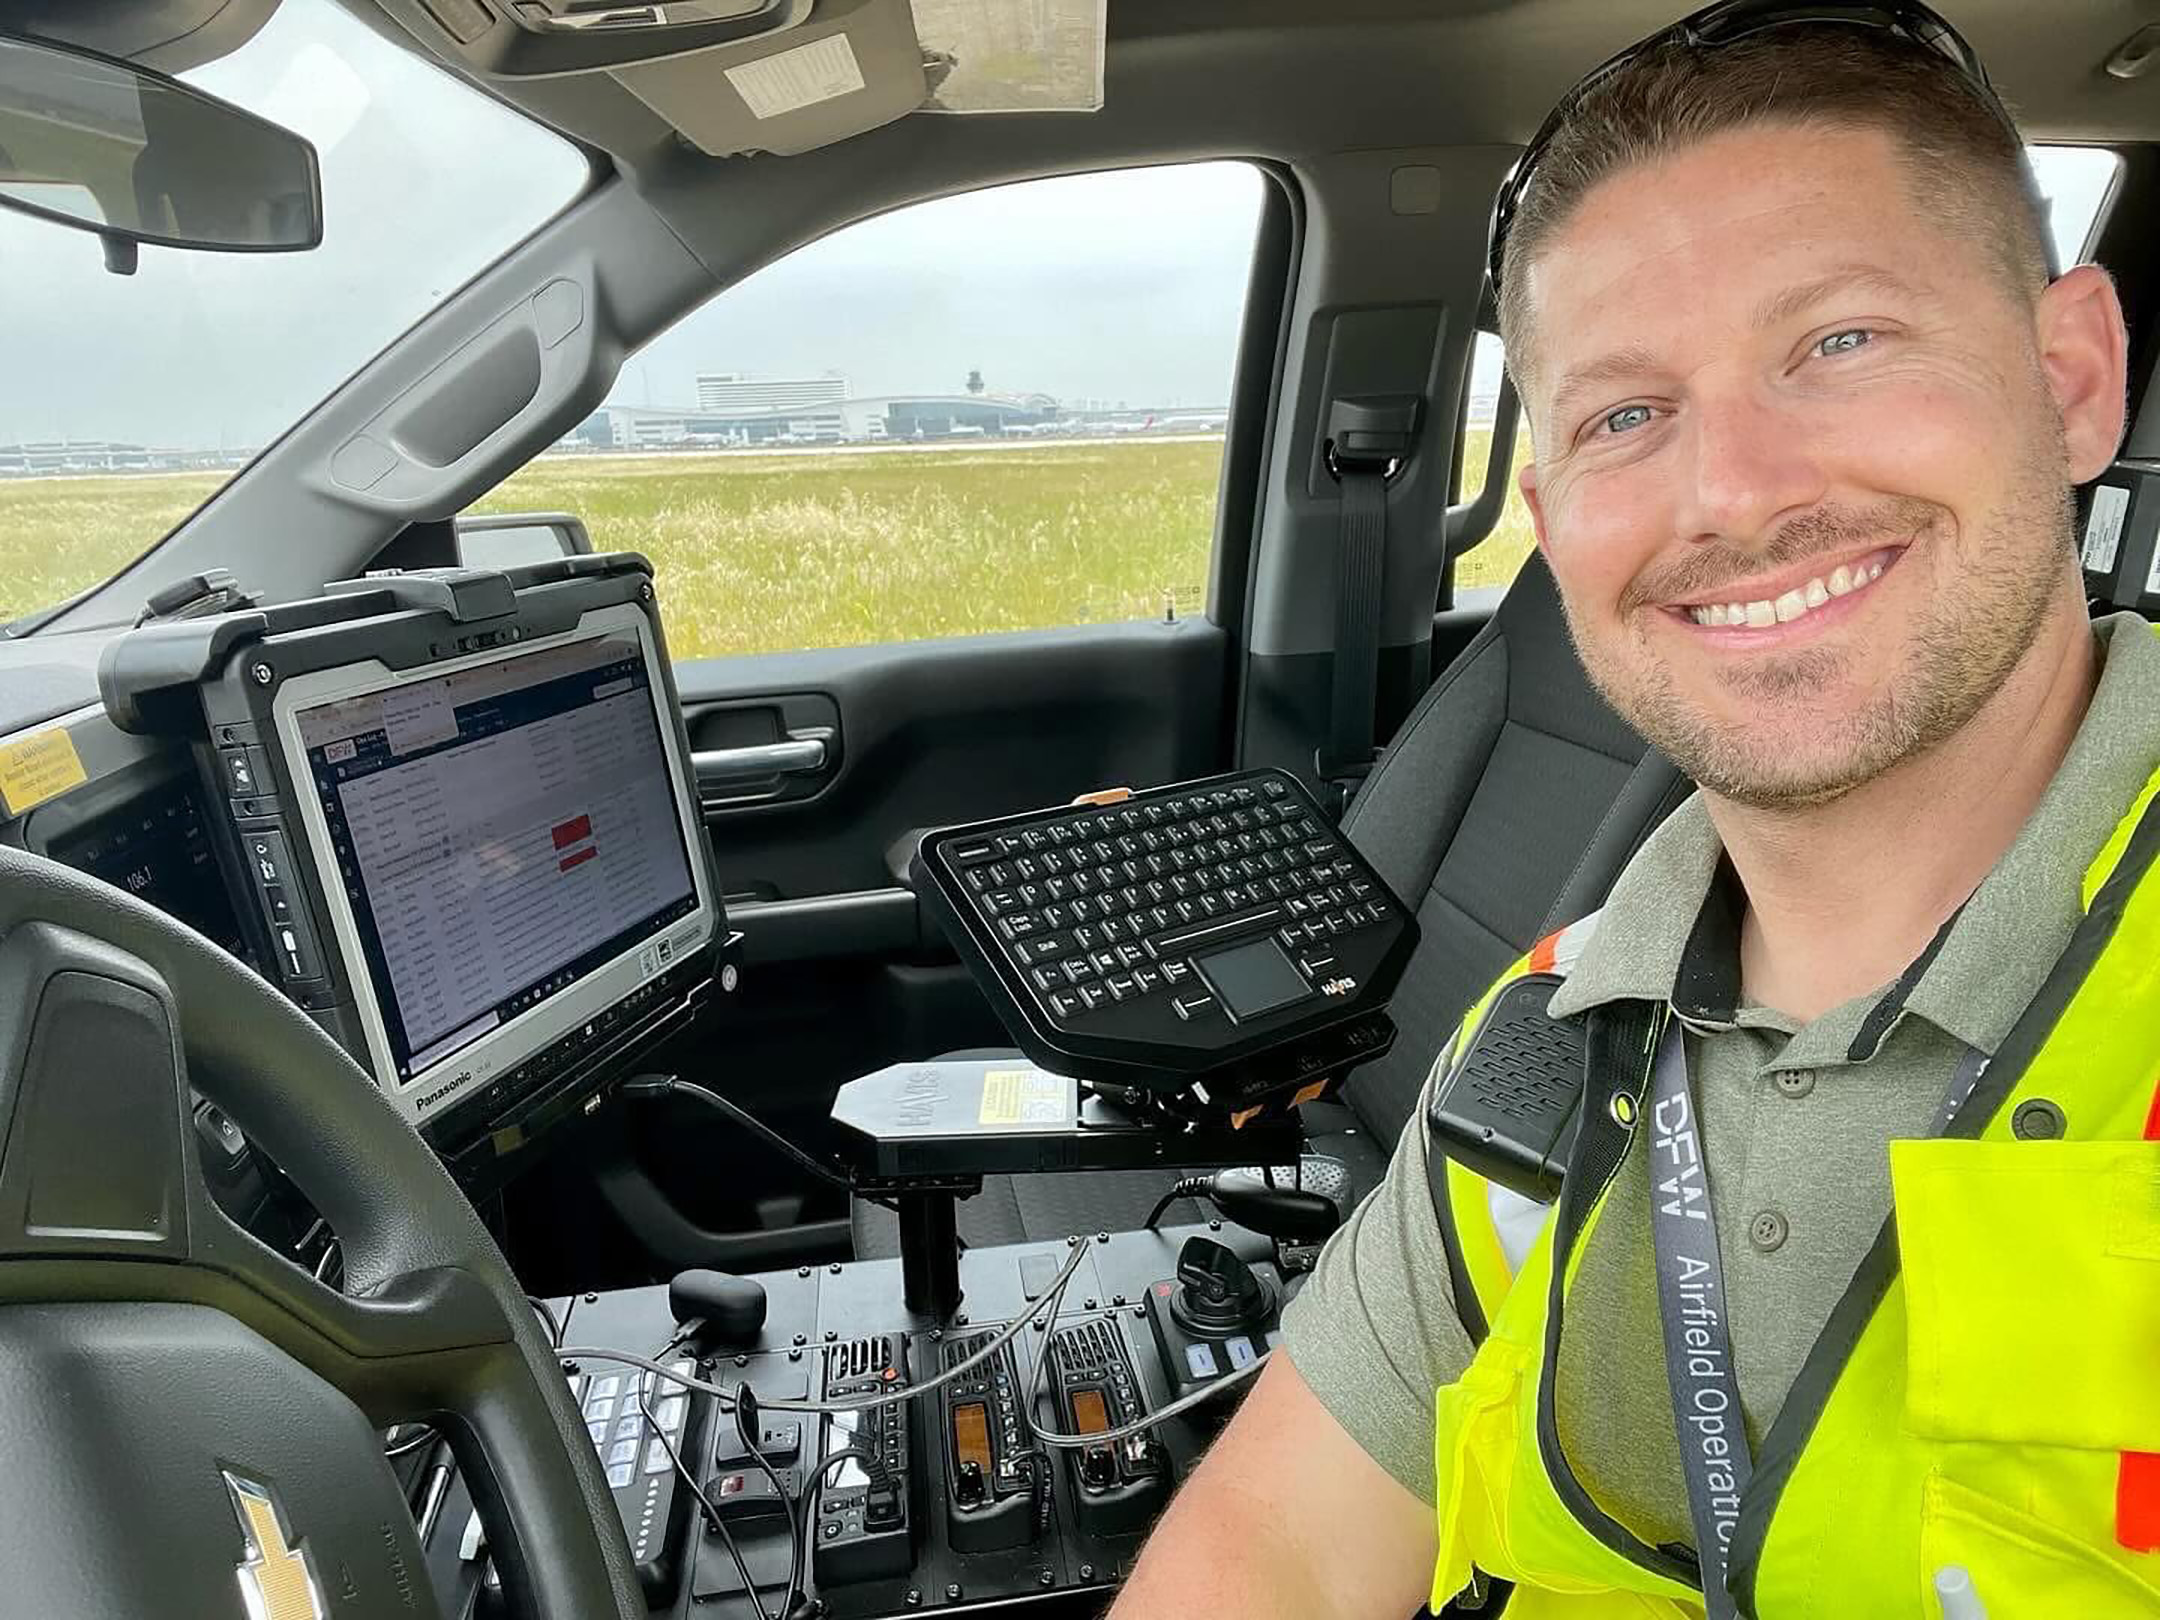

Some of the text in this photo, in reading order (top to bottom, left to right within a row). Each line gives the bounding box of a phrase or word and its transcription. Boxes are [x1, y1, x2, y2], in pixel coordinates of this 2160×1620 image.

[126, 865, 153, 891] 106.1
[415, 1071, 472, 1112] Panasonic
[1655, 1091, 1741, 1591] DFW Airfield Operatio
